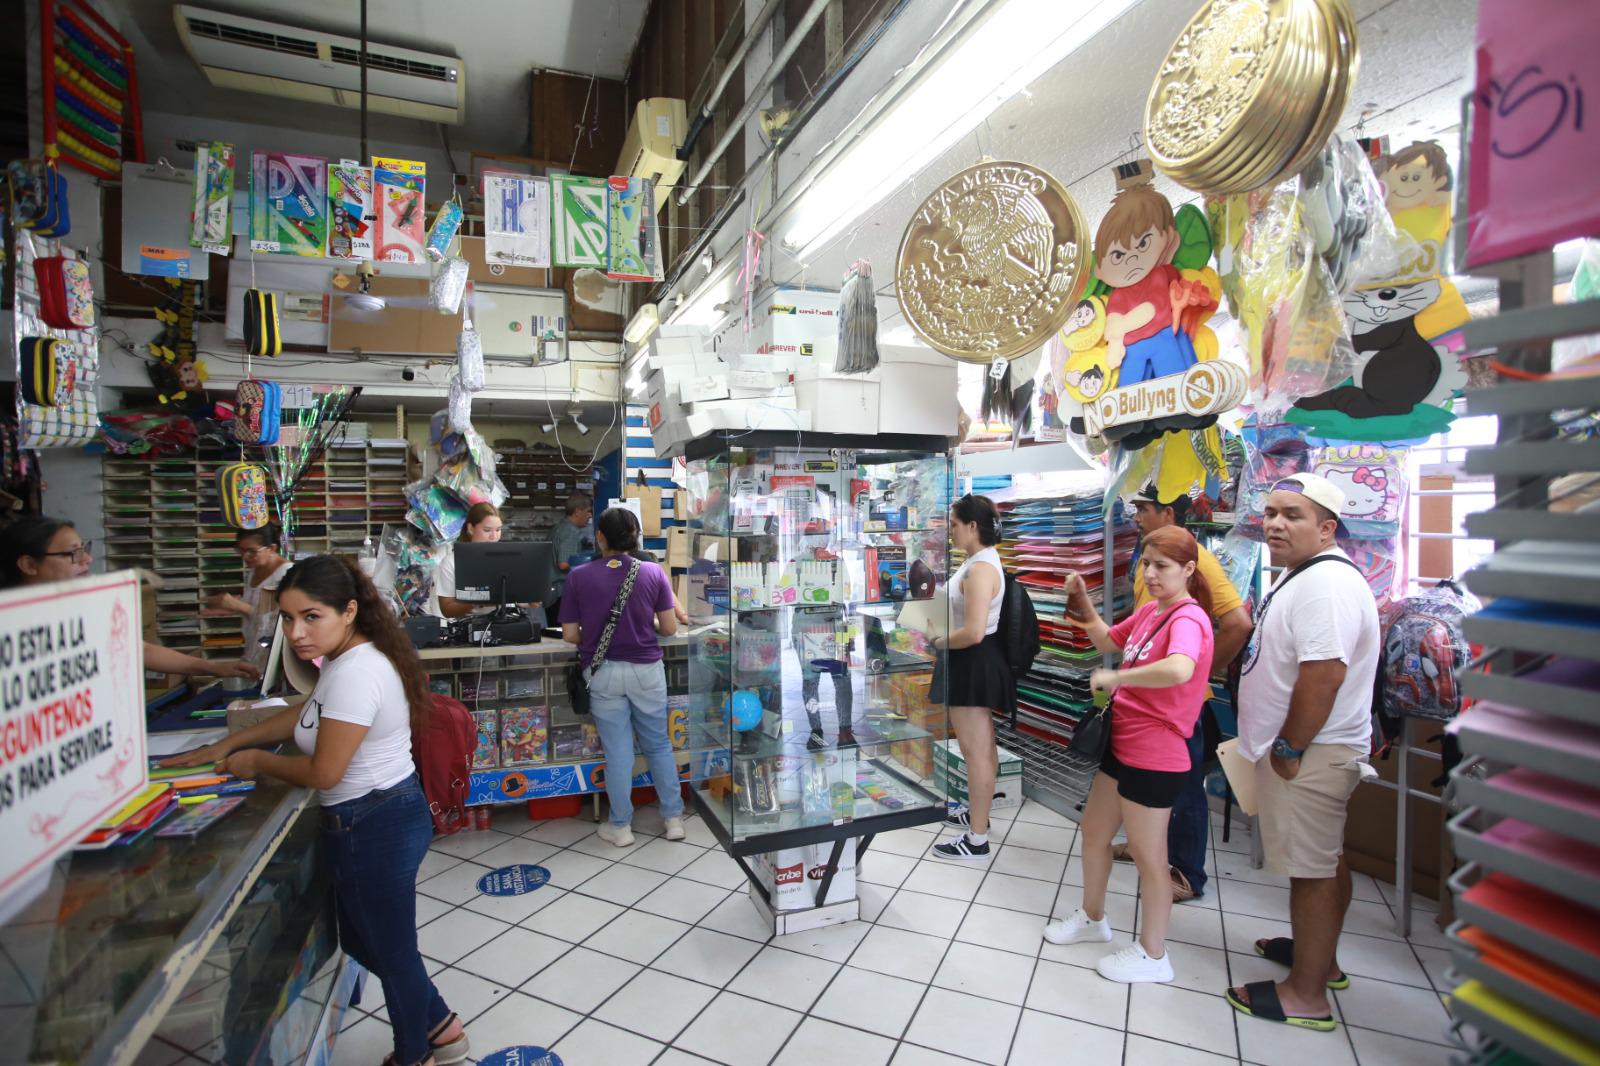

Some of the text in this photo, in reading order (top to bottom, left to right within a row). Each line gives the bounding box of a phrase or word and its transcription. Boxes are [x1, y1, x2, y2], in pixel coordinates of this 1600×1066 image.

[1083, 386, 1176, 438] NO Bullyng
[19, 624, 53, 665] ESTA
[57, 620, 67, 650] A
[70, 616, 85, 648] LA
[3, 649, 99, 711] LO QUE BUSCA
[19, 751, 55, 800] PARA
[59, 720, 113, 777] SERVIRLE
[511, 865, 525, 894] DISTANCIA
